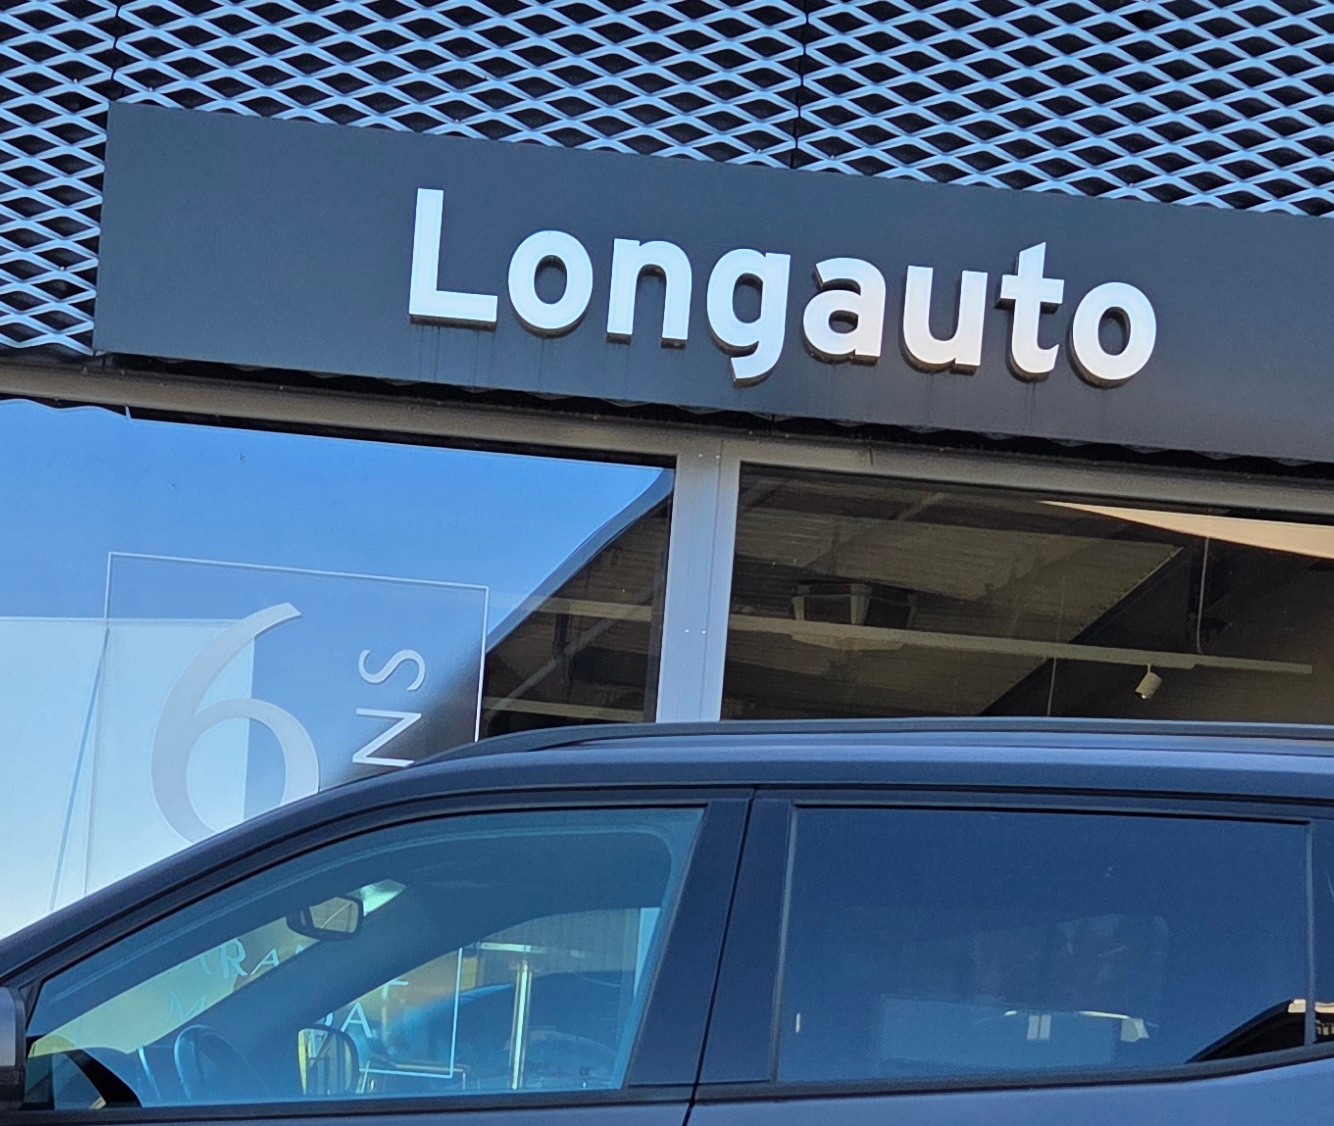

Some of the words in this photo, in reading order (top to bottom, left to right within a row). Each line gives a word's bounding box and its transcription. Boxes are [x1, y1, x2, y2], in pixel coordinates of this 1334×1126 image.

[408, 187, 1158, 387] Longauto
[151, 602, 320, 843] 6
[352, 648, 427, 768] NS
